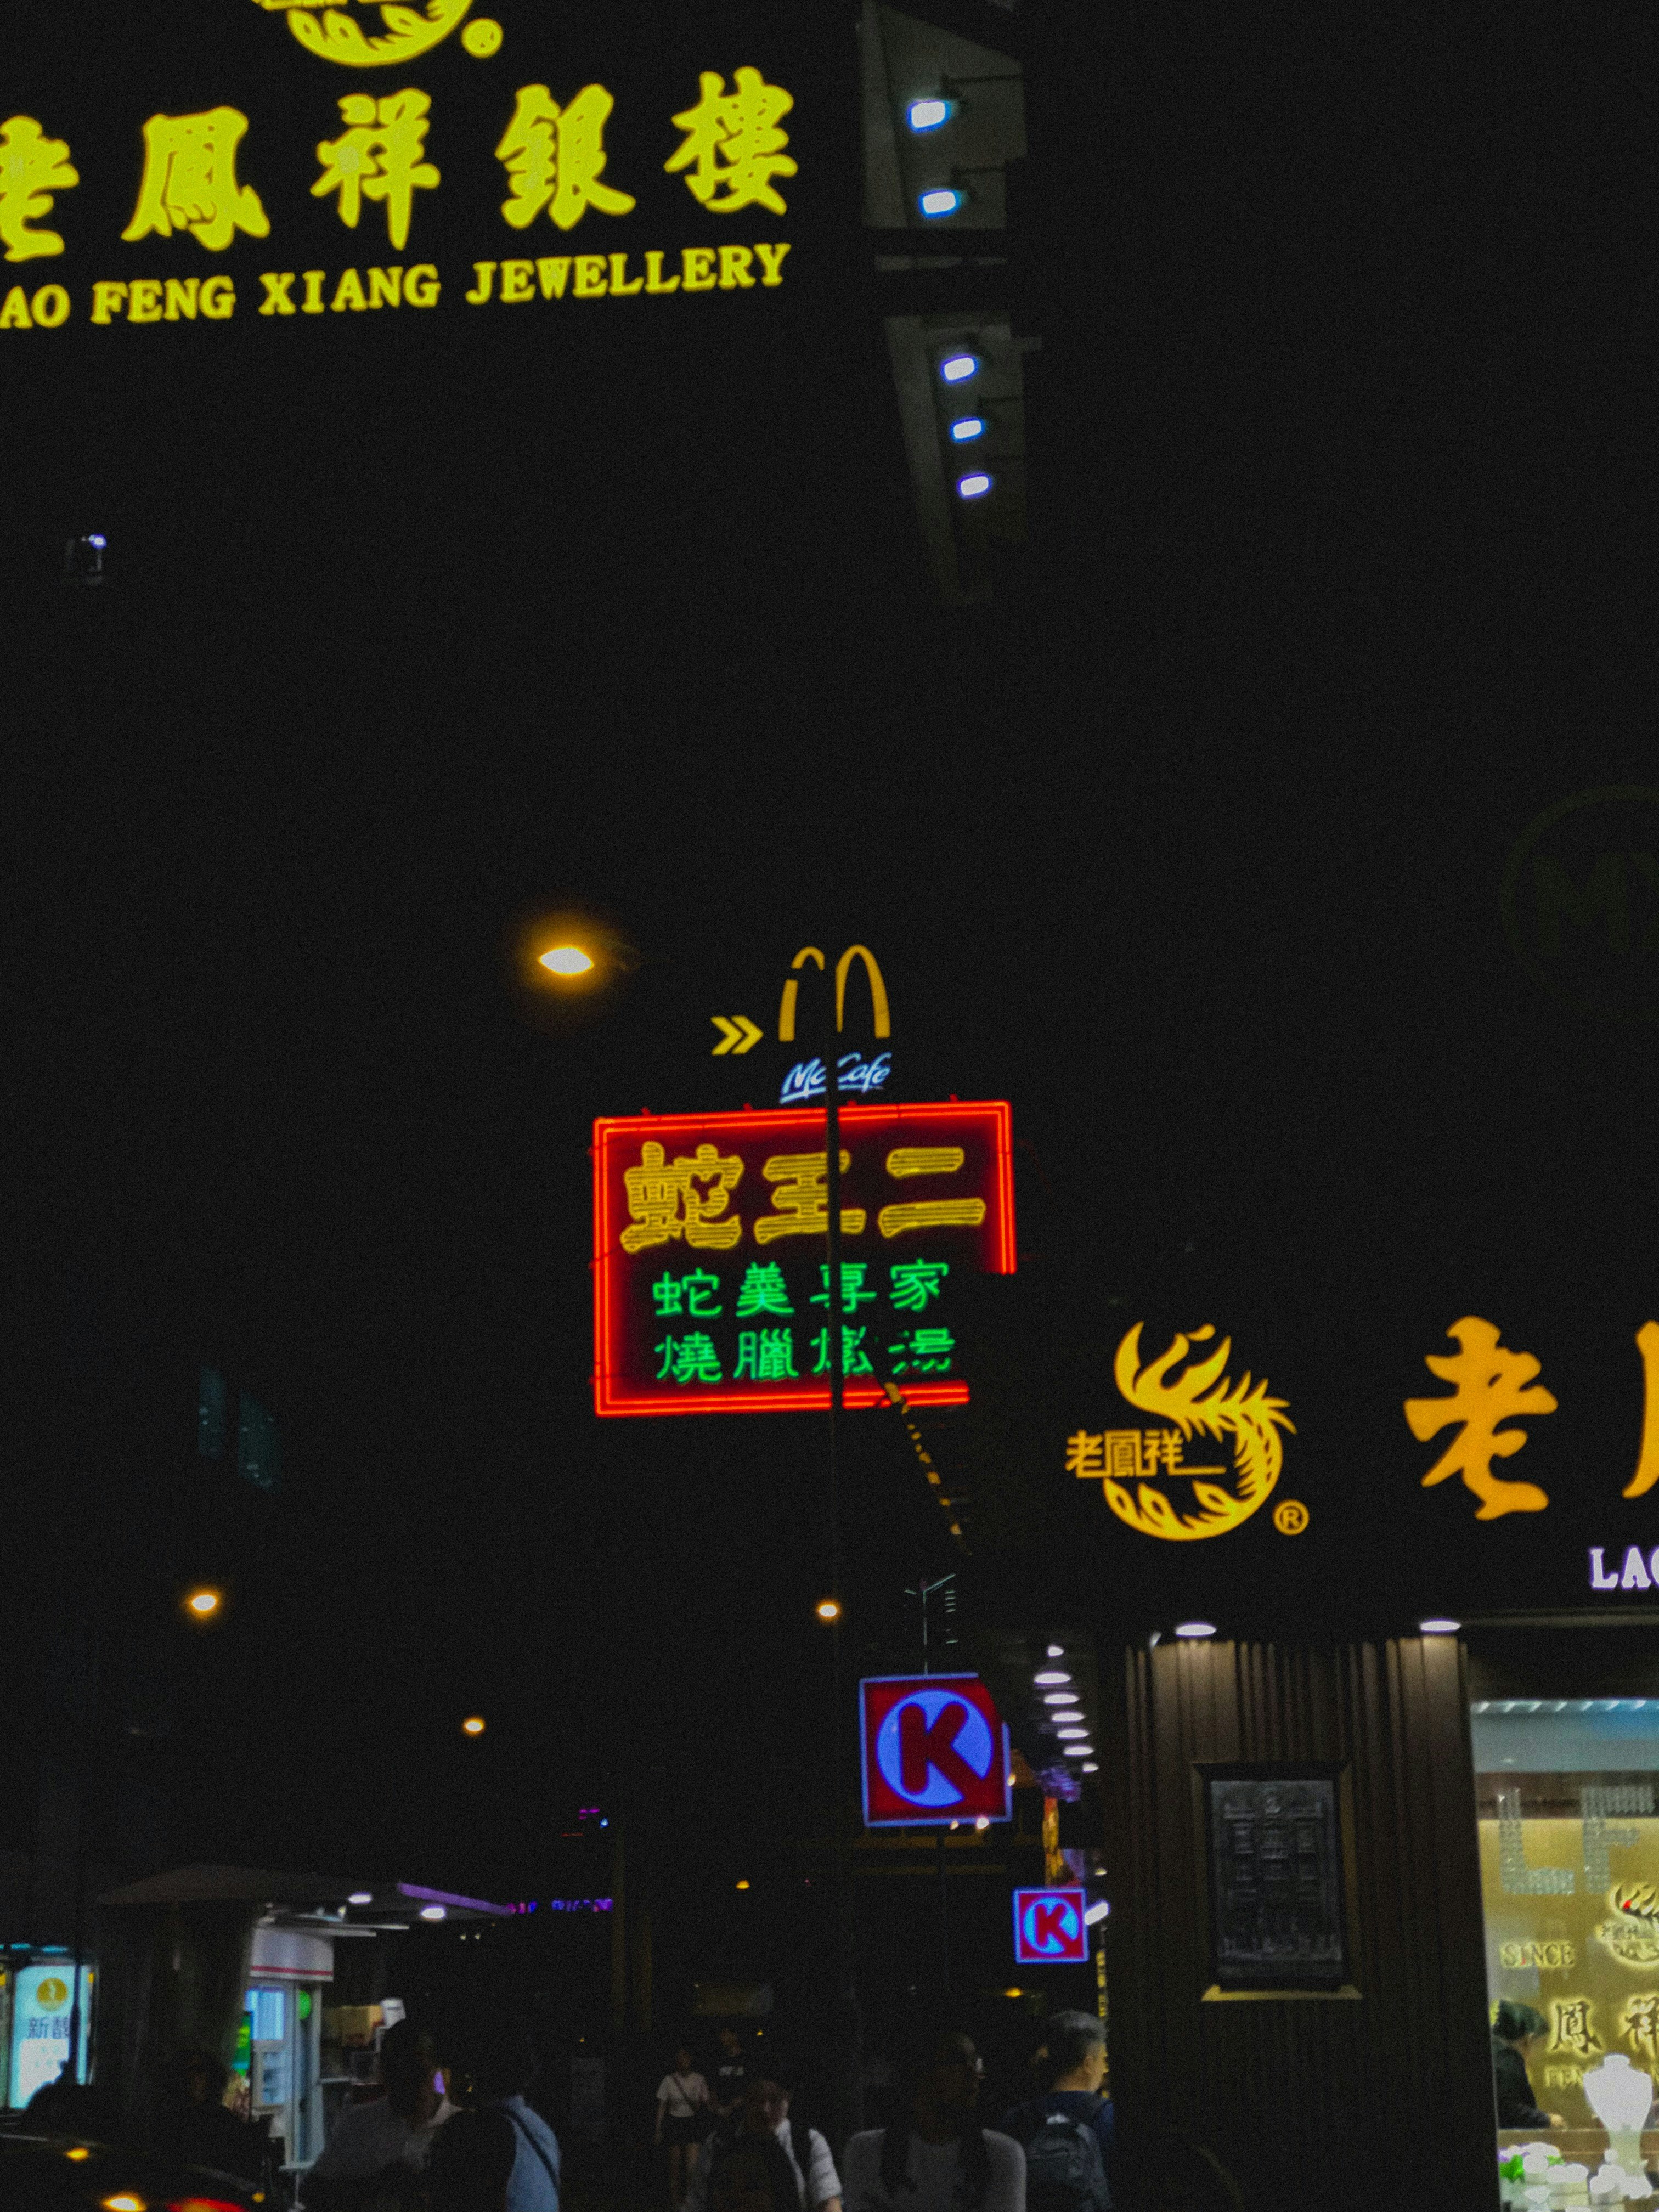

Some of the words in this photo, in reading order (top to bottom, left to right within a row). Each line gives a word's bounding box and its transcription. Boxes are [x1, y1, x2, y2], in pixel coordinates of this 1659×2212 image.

[90, 275, 236, 325] FENG
[258, 263, 441, 315] XIANG
[465, 243, 791, 304] JEWELLERY
[620, 1141, 986, 1252] 蛇王二
[1403, 1316, 1659, 1521] 老
[1064, 1429, 1227, 1478] 老鳳祥
[1588, 1545, 1659, 1590] LA
[899, 1702, 986, 1799] K
[1035, 1903, 1079, 1953] K
[1503, 1943, 1575, 1966] SINCE
